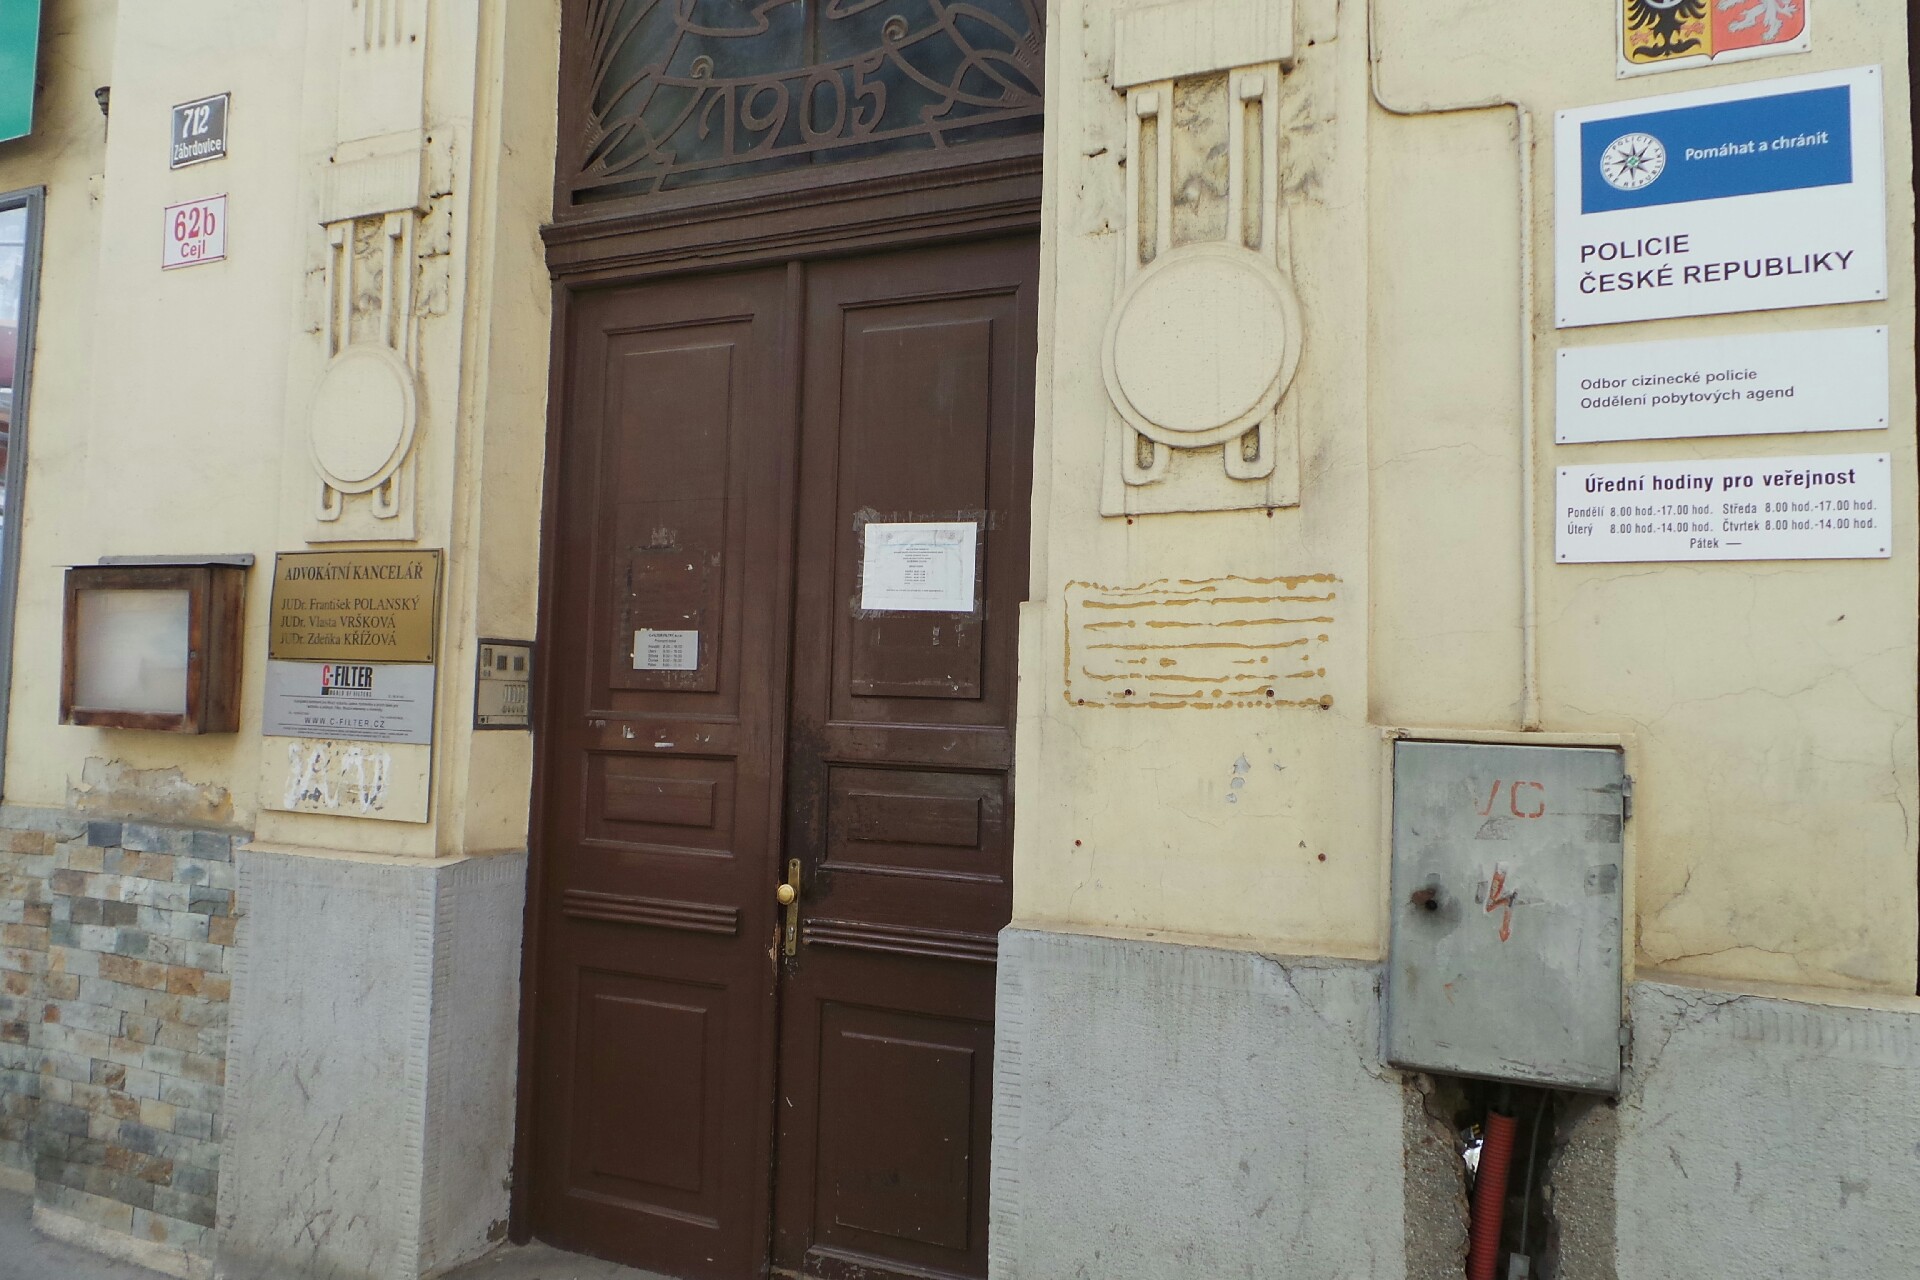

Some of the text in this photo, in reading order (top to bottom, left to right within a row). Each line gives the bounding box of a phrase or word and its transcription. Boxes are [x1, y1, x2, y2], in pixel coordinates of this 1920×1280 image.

[699, 54, 886, 156] 1905
[182, 105, 211, 138] 712
[173, 138, 222, 160] Zábrdovice
[1685, 131, 1829, 161] Pomáhat a chránit
[174, 207, 216, 241] 62b
[181, 240, 206, 258] Cejl
[1580, 234, 1690, 263] POLICIE
[1579, 250, 1854, 294] ČESKÉ REPUBLIKY
[1580, 368, 1758, 390] Odbor cizinecké policie
[1580, 386, 1795, 409] Oddělení pobytových agend
[1585, 468, 1856, 493] Úřední hodiny pro veřejnost
[1567, 505, 1604, 518] Pondělí
[1610, 506, 1632, 517] 8.00
[1692, 504, 1713, 515] hod.
[1722, 502, 1757, 514] Středa
[1765, 501, 1788, 513] 8.00
[1853, 499, 1877, 511] hod.
[1567, 521, 1593, 536] Úterý
[1610, 523, 1632, 534] 8.00
[1692, 521, 1713, 532] hod.
[1722, 518, 1760, 532] Čtvrtek
[1765, 519, 1788, 531] 8.00
[1853, 517, 1877, 529] hod.
[1690, 537, 1719, 549] Pátek
[284, 561, 423, 581] ADVOKÁTNÍ KANCELÁŘ
[281, 595, 420, 611] JUDr. František POLANSKÝ
[280, 613, 396, 628] JUDr. Vlasta VRŠKOVÁ
[307, 633, 341, 645] Zdeňka
[344, 630, 397, 646] KŘÍŽOVÁ
[322, 665, 373, 688] C-FILTER
